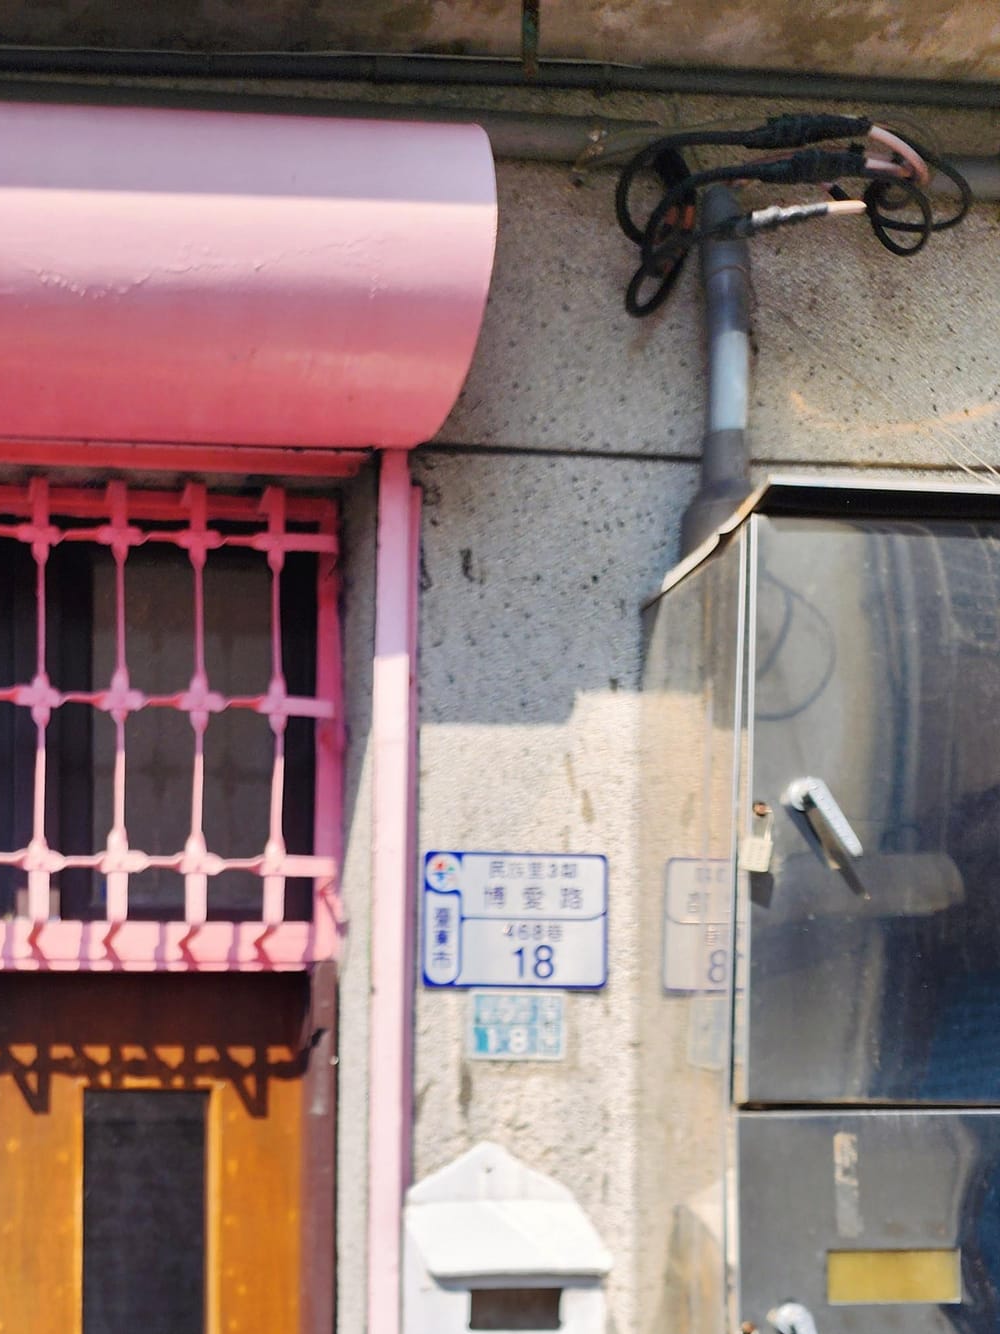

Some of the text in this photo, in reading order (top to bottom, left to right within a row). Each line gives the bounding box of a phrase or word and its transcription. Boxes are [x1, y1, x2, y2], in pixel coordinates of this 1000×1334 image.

[483, 886, 584, 910] 博愛路
[512, 944, 555, 980] 18
